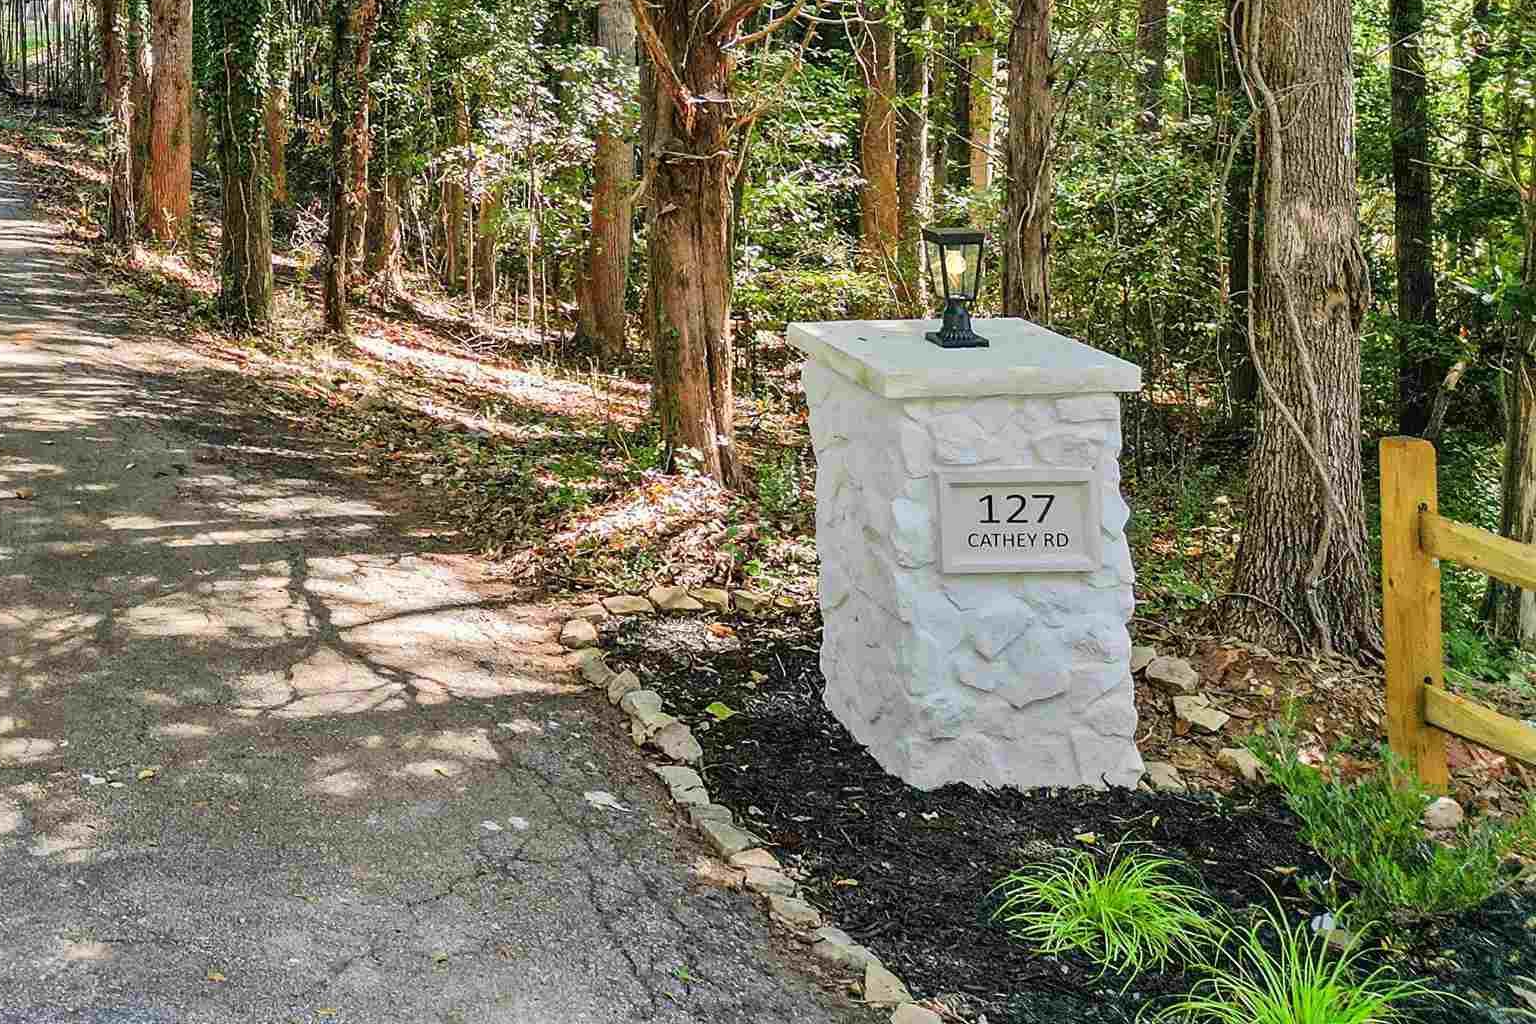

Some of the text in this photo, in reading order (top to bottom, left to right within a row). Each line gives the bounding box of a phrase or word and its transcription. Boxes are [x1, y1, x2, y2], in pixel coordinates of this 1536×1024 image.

[978, 494, 1056, 524] 127
[967, 532, 1069, 548] CATHEY RD
